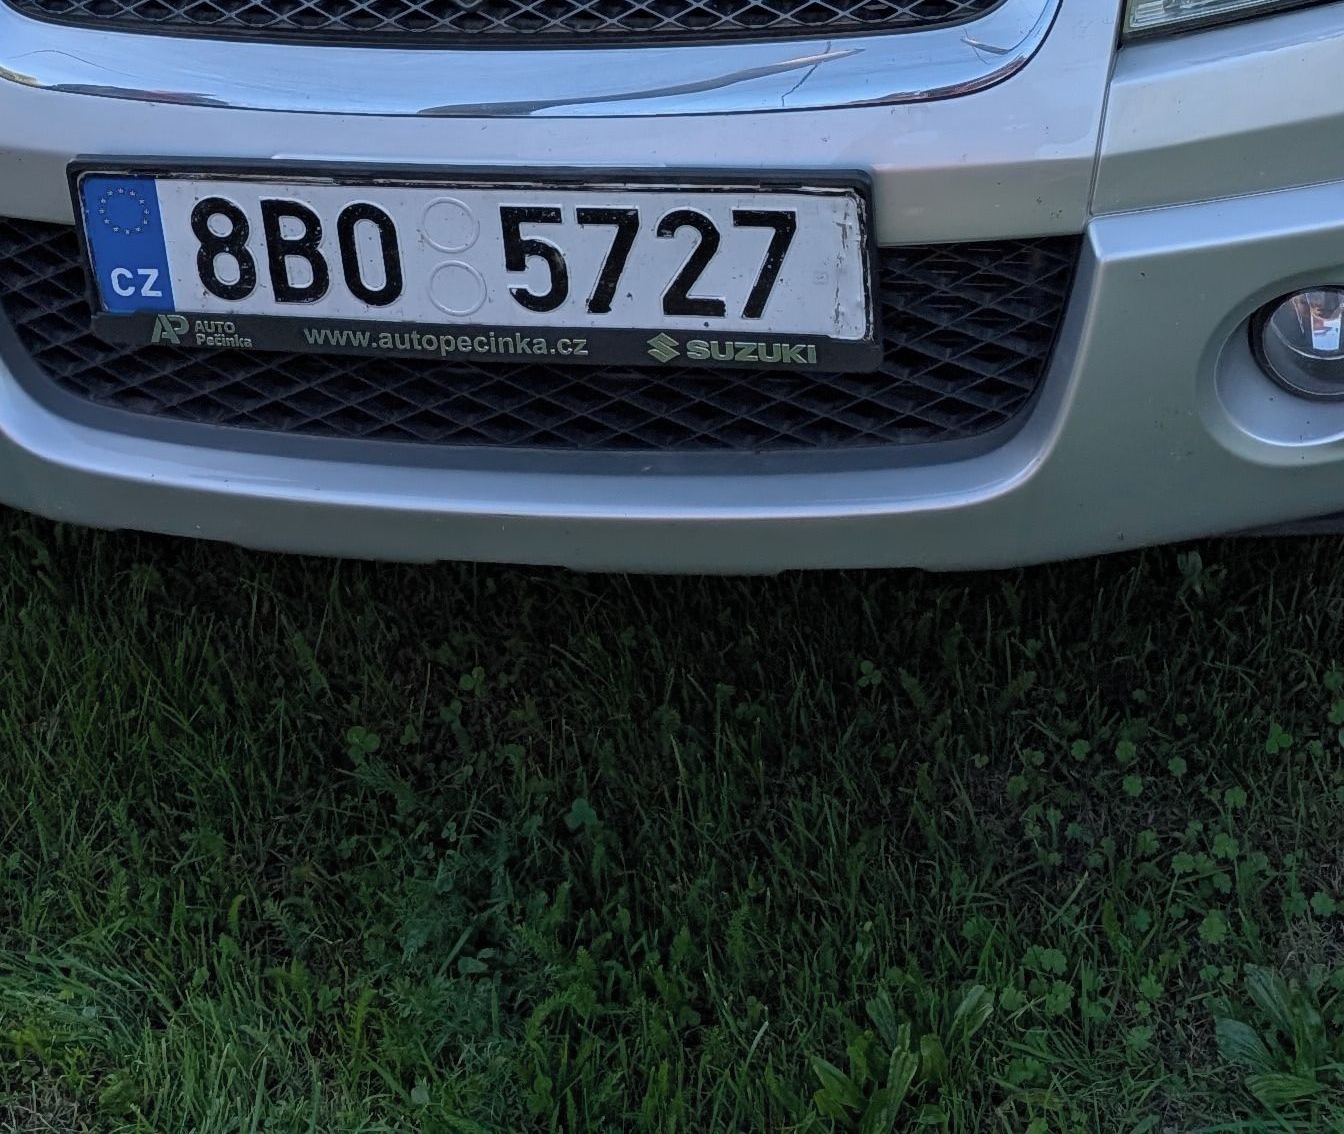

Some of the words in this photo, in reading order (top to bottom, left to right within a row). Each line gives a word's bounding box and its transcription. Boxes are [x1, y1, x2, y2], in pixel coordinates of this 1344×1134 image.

[190, 195, 404, 307] 8B0
[499, 205, 797, 319] 5727
[110, 267, 163, 298] CZ
[194, 320, 236, 334] AUTO
[196, 332, 254, 348] Pečinka
[304, 328, 588, 356] www.autopecinka.cz
[686, 339, 817, 365] SUZUKI
